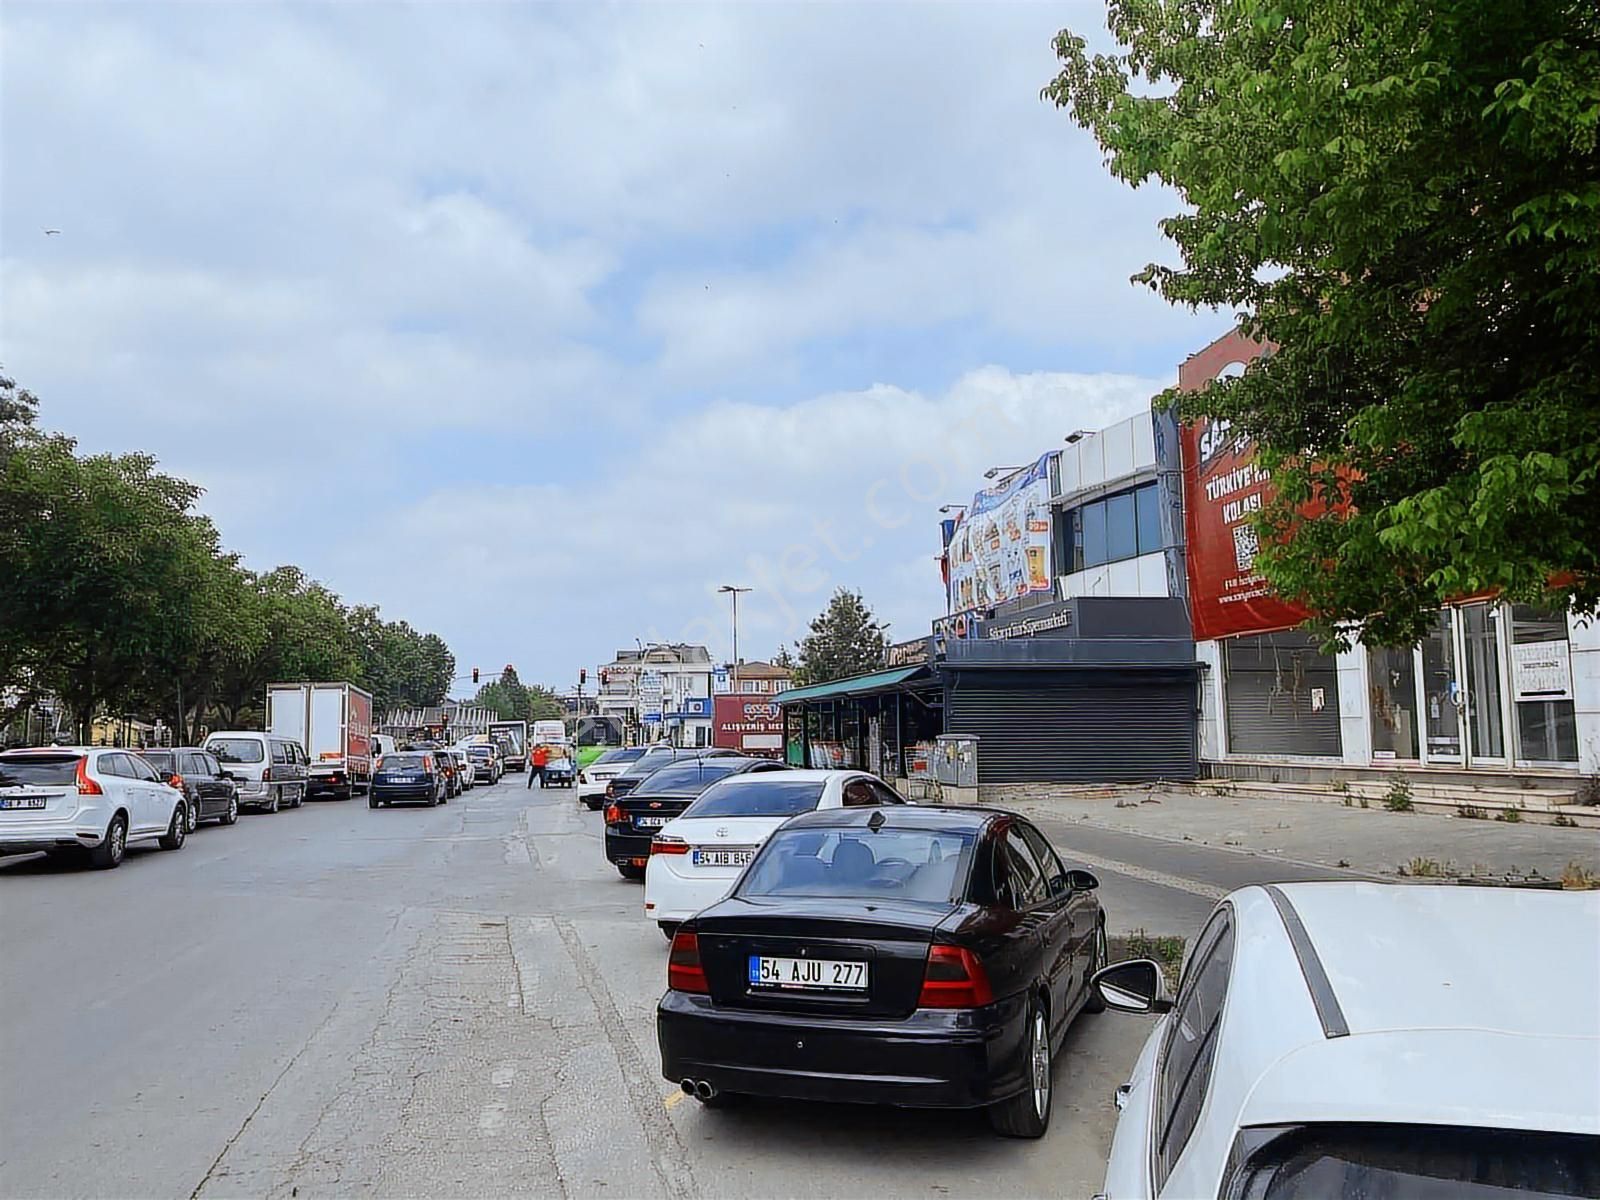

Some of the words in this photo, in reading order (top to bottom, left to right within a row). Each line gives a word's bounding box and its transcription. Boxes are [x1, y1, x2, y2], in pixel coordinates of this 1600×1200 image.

[1223, 493, 1262, 524] KOLASI
[721, 721, 765, 733] ALIŞVERİŞ
[700, 853, 710, 864] 54
[760, 958, 781, 980] 54
[791, 960, 822, 982] AJU
[833, 963, 863, 985] 277
